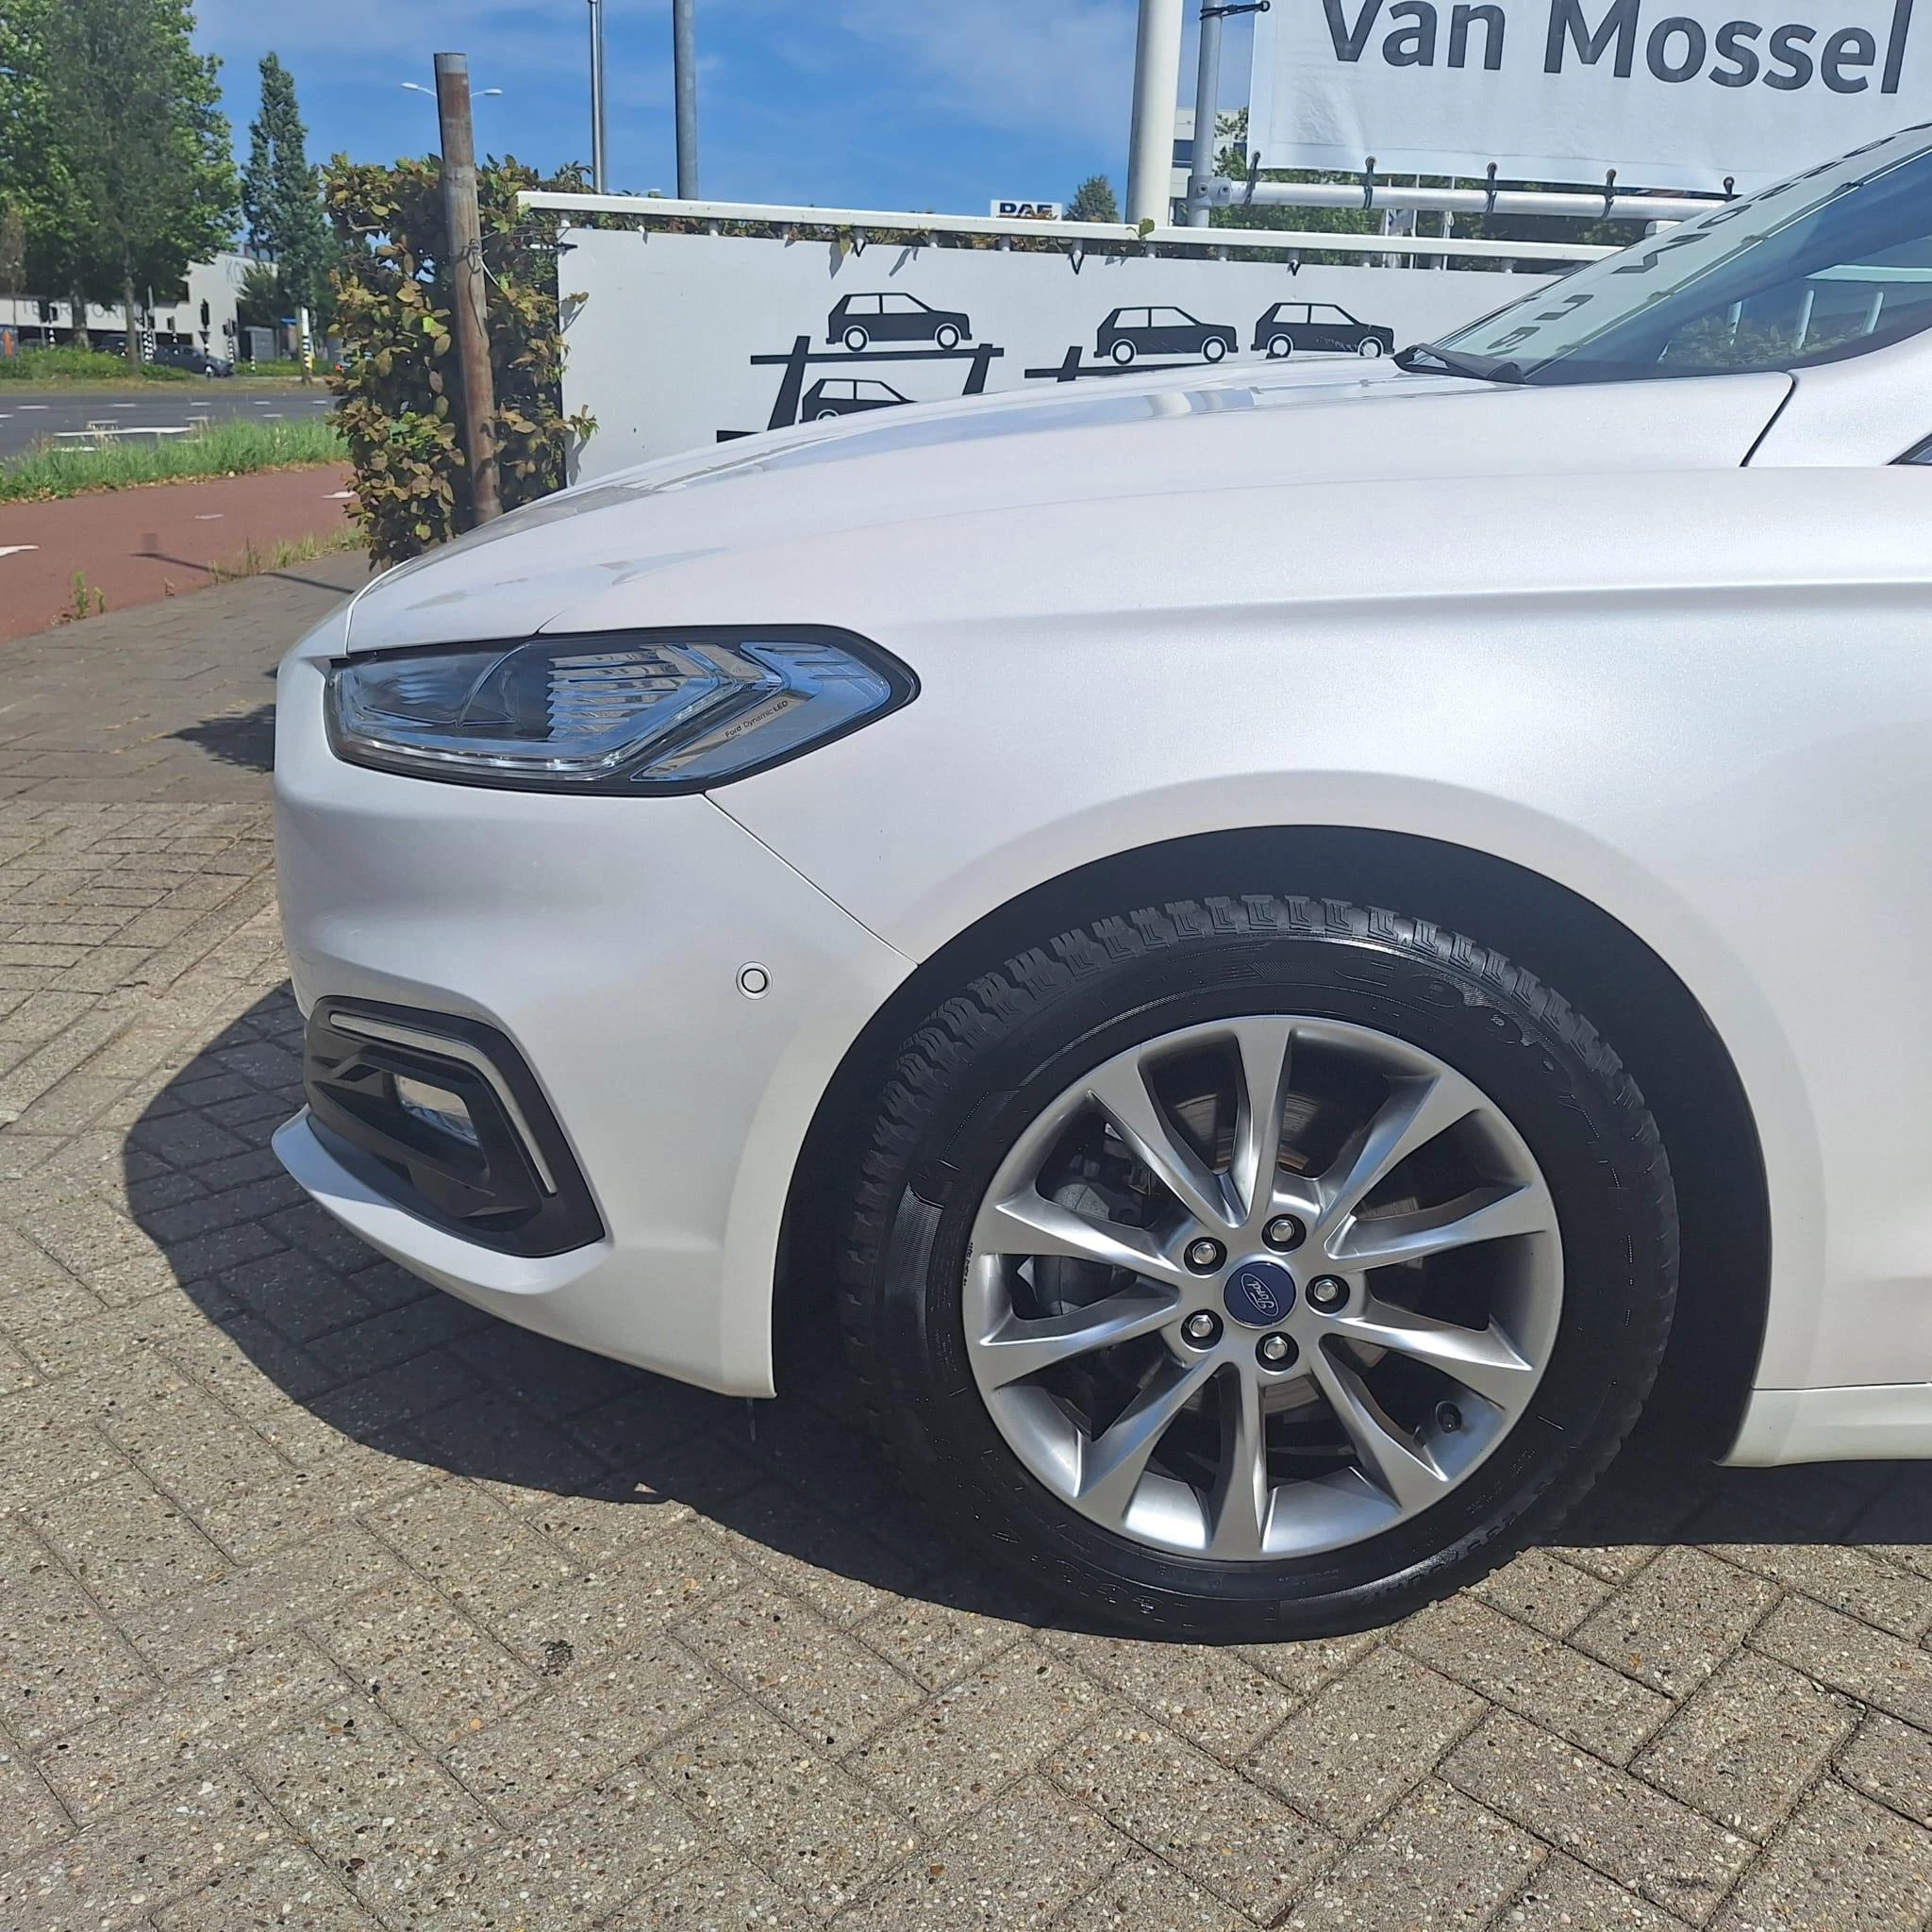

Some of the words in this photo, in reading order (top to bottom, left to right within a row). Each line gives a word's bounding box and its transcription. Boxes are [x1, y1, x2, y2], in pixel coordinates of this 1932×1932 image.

[1323, 0, 1507, 71] Van
[1543, 0, 1914, 95] Mossel
[724, 725, 742, 738] Ford
[742, 708, 774, 726] Dynamic
[774, 700, 789, 712] LED
[1246, 1280, 1274, 1309] Ford
